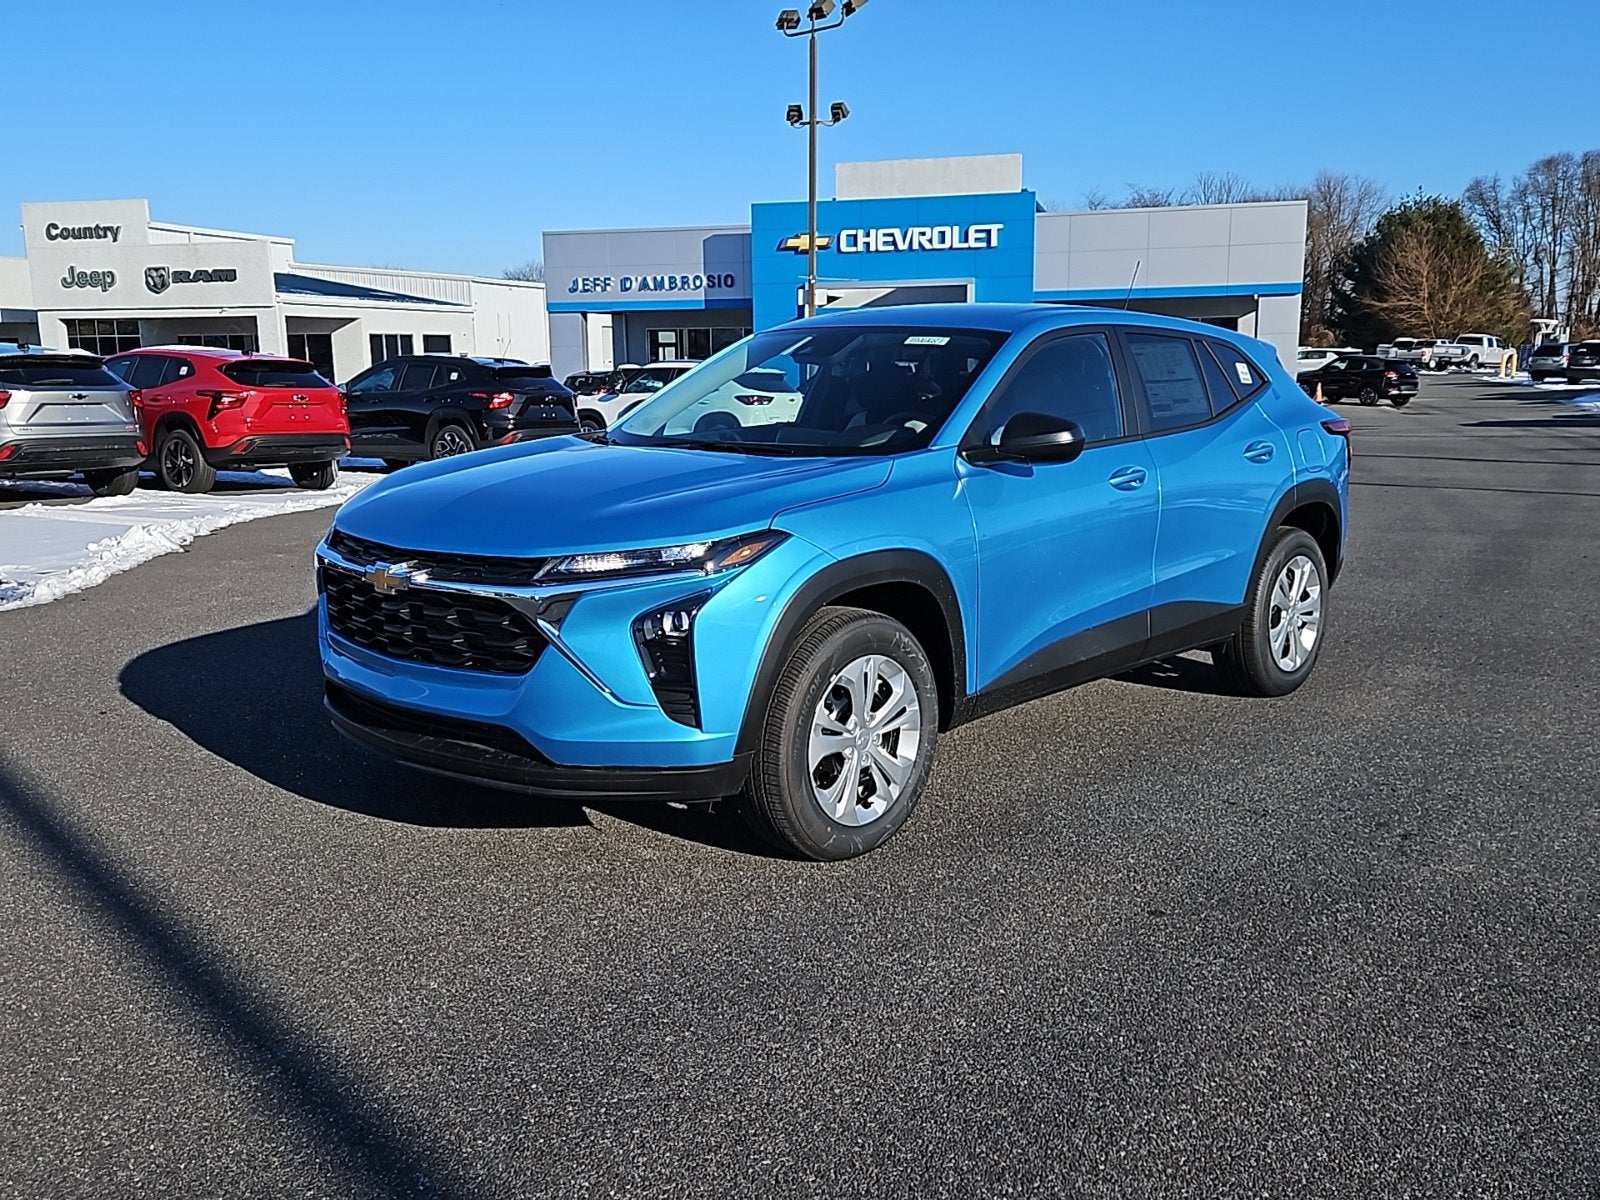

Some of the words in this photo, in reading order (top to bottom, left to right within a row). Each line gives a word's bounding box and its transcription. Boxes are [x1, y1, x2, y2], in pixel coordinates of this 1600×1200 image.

[45, 221, 122, 243] Country
[838, 223, 1004, 253] CHEVROLET
[61, 265, 117, 293] Jeep
[171, 268, 237, 284] RAM
[568, 276, 613, 293] JEFF
[620, 273, 735, 293] D'AMBROSIO
